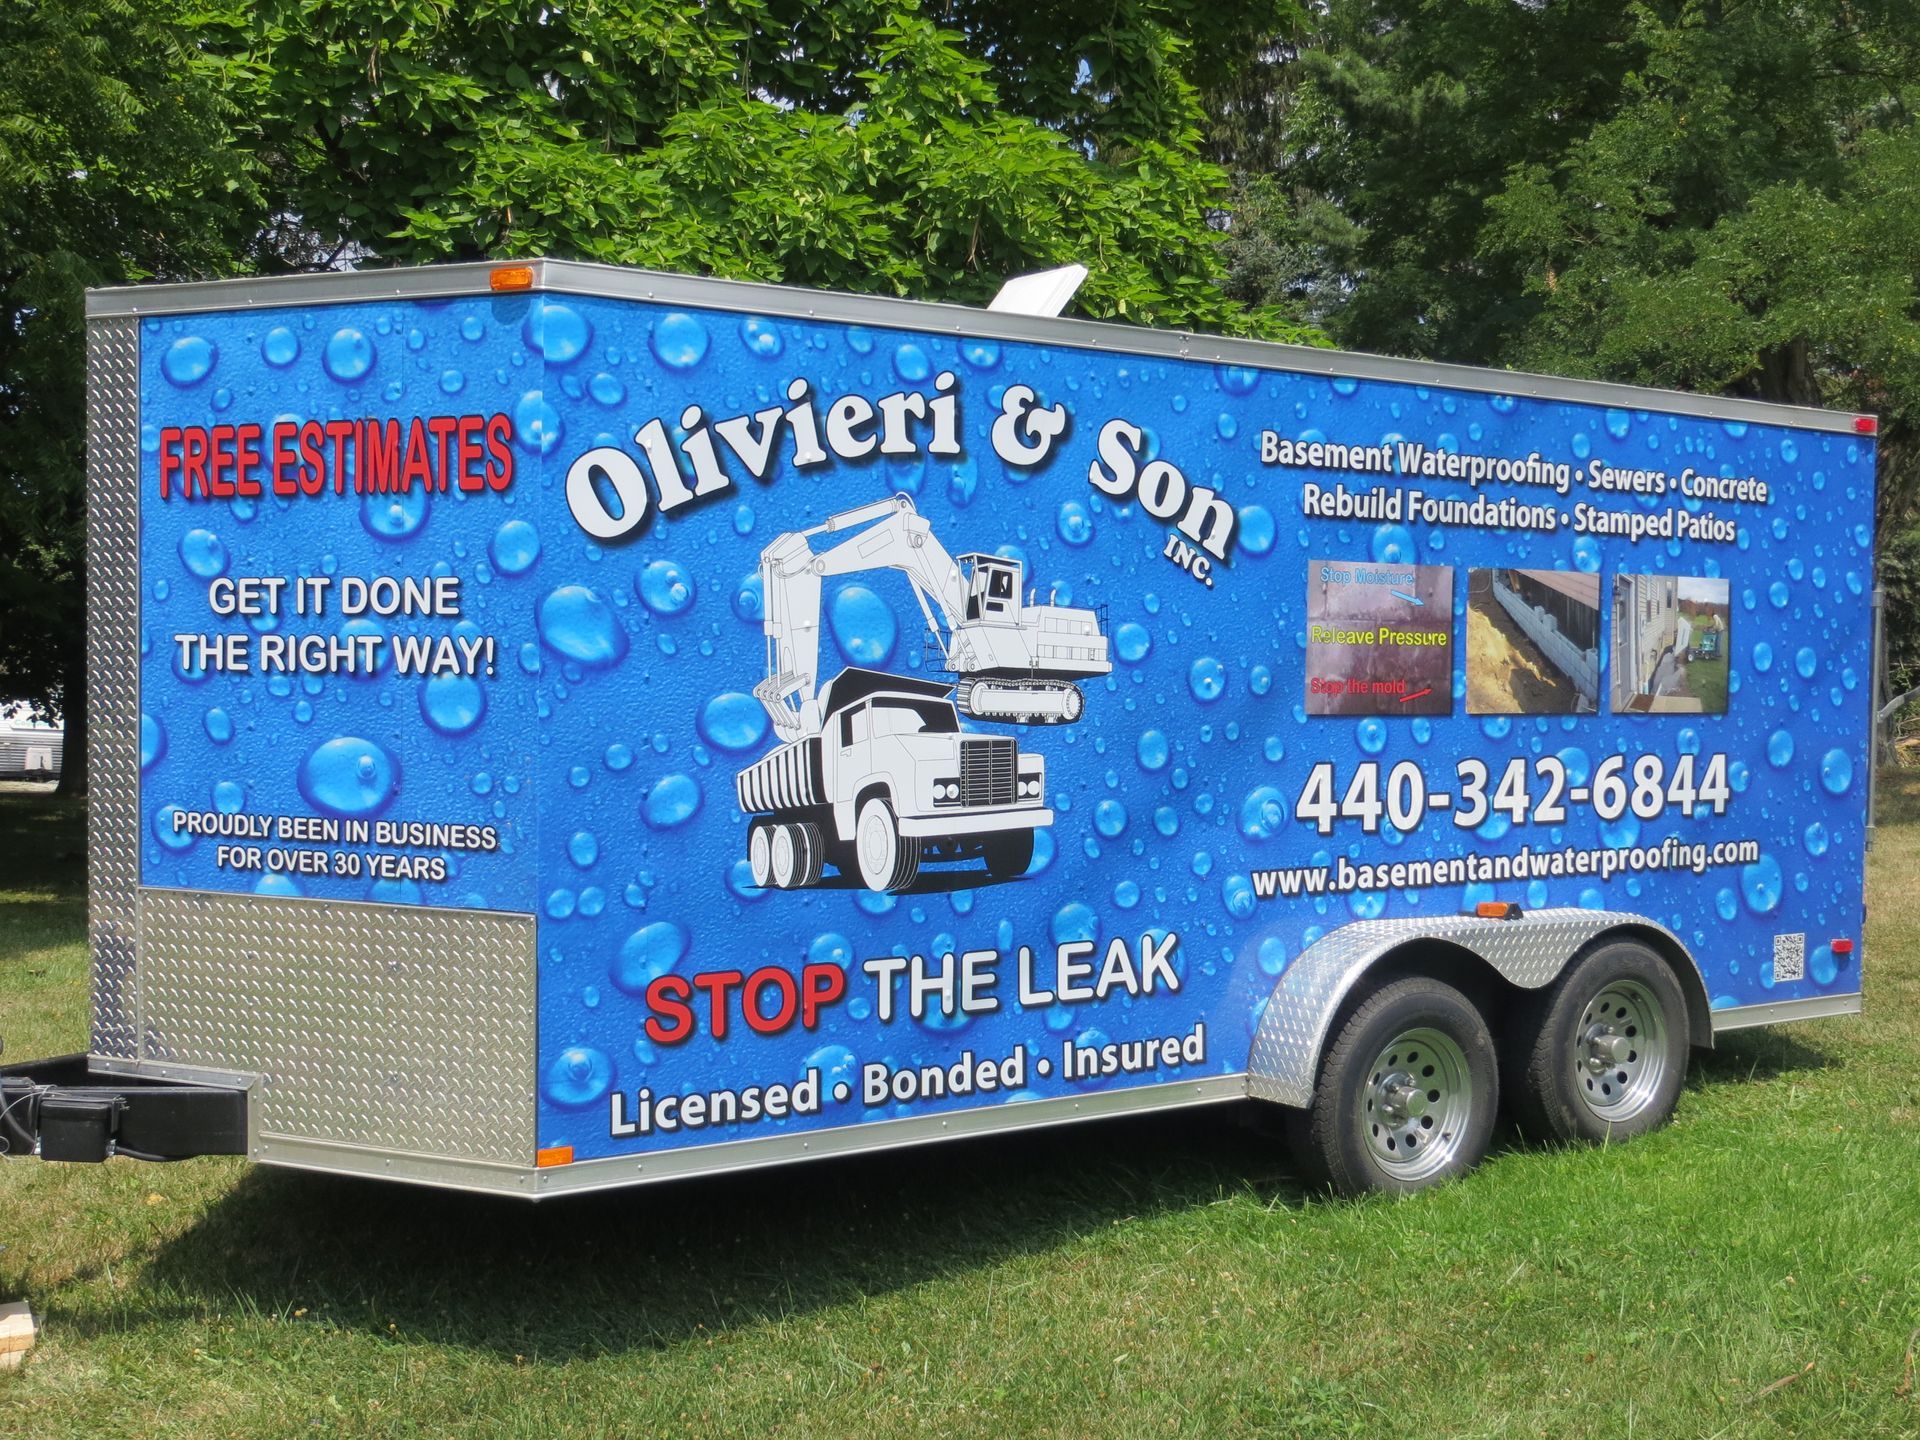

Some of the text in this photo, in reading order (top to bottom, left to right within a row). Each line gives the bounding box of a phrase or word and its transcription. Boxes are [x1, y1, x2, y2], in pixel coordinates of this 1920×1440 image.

[159, 413, 514, 499] FREE ESTIMATES
[565, 371, 1236, 560] Olivieri & Son
[1261, 430, 1768, 503] Basement Waterproofing Sewers Concrete
[1303, 483, 1735, 543] Rebuild Foundations Stamped Patios
[1163, 534, 1213, 586] INC.
[1320, 566, 1415, 585] Stop Moisture
[209, 577, 460, 615] GET IT DONE
[175, 635, 495, 675] THE RIGHT WAY!
[1311, 626, 1447, 646] Releave Pressure
[1311, 677, 1406, 696] Stop the mold
[1296, 753, 1730, 834] 440-342-6844
[173, 811, 496, 848] PROUDLY BEEN IN BUSINESS
[217, 846, 446, 881] FOR OVER 30 YEARS
[1252, 839, 1760, 896] www.basementandwaterproofing.com
[644, 933, 1179, 1043] STOP THE LEAK
[611, 1024, 1203, 1136] Licensed Bonded Insured
